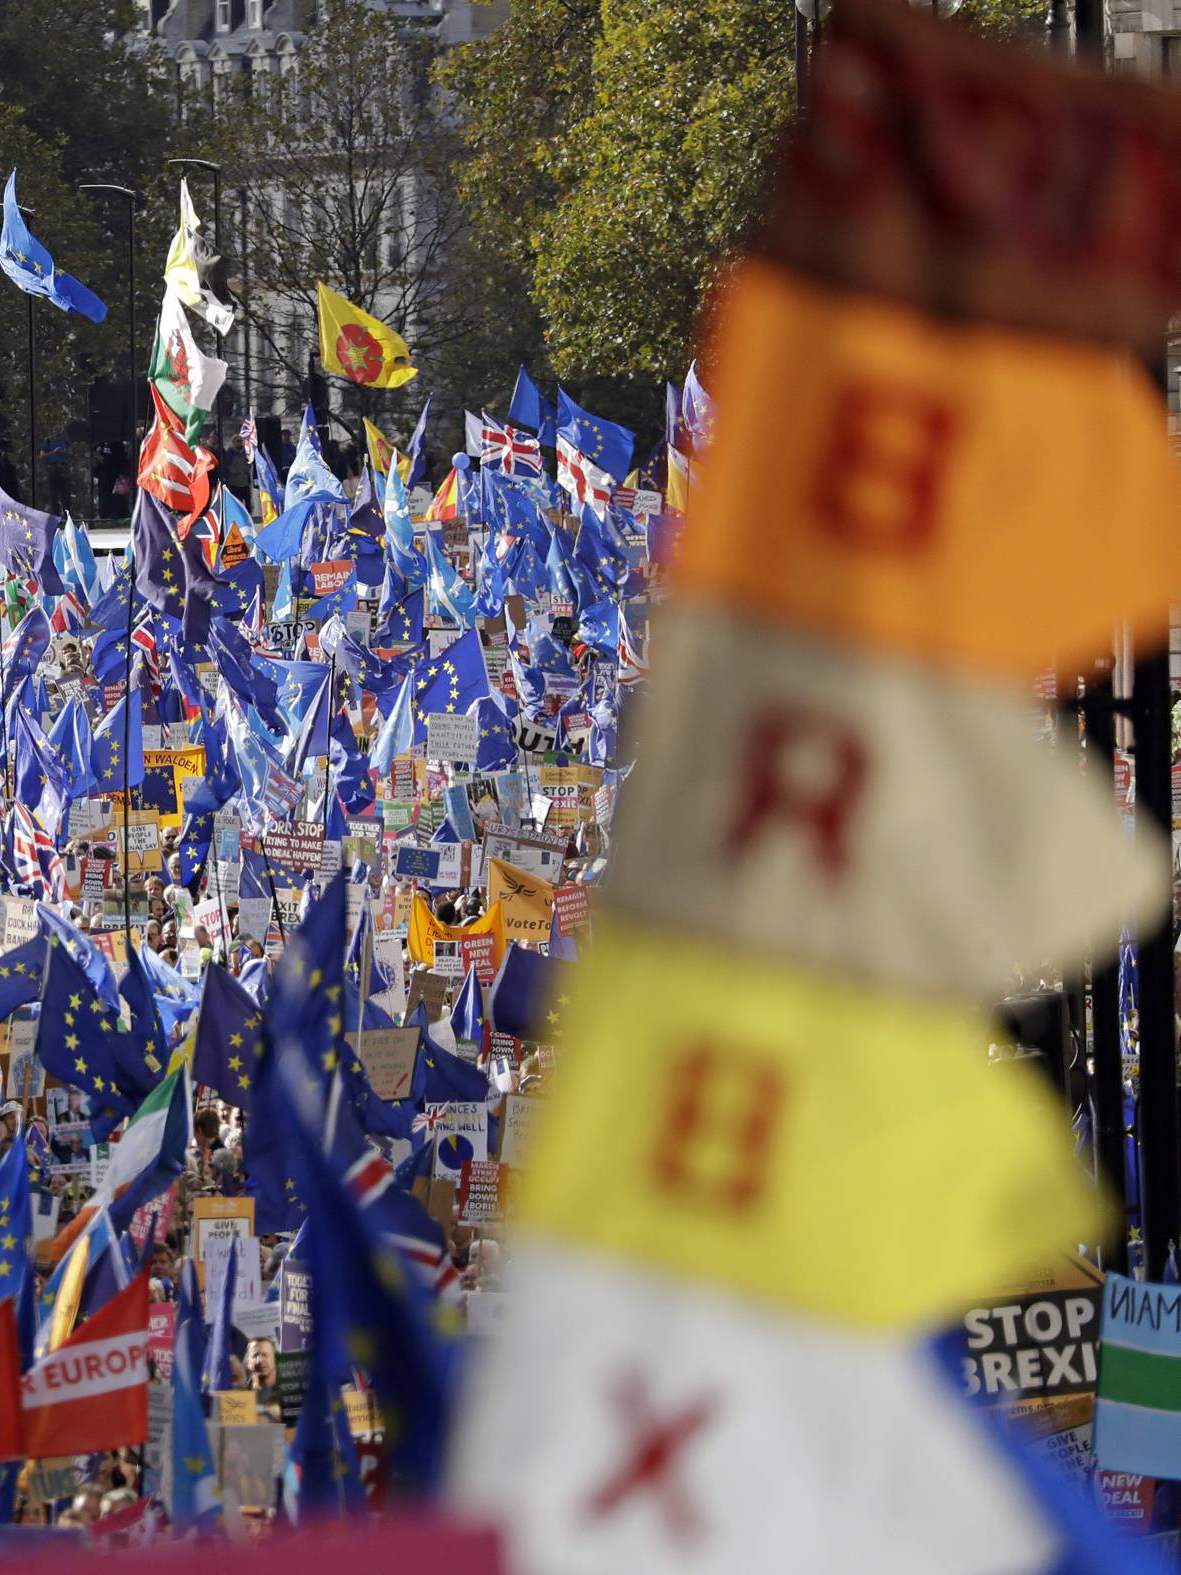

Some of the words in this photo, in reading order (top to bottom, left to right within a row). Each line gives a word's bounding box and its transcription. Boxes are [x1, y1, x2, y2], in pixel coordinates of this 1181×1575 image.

[271, 623, 315, 641] STOP
[156, 755, 198, 773] WALDEN
[542, 786, 575, 796] STOP
[298, 822, 324, 837] STOP
[263, 836, 287, 847] TRYING
[290, 838, 300, 847] TO
[301, 840, 322, 850] MAKE
[272, 848, 291, 859] DEAL
[557, 892, 586, 903] REMAIN
[464, 938, 493, 949] GREEN
[469, 949, 490, 959] NEW
[458, 1122, 485, 1132] WELL
[470, 1184, 497, 1192] BRING
[469, 1193, 498, 1202] DOWN
[214, 1220, 237, 1229] GIVE
[964, 1298, 1095, 1349] STOP
[45, 1344, 149, 1389] EUROP
[961, 1341, 1099, 1396] BREXI
[1103, 1474, 1143, 1491] NEW
